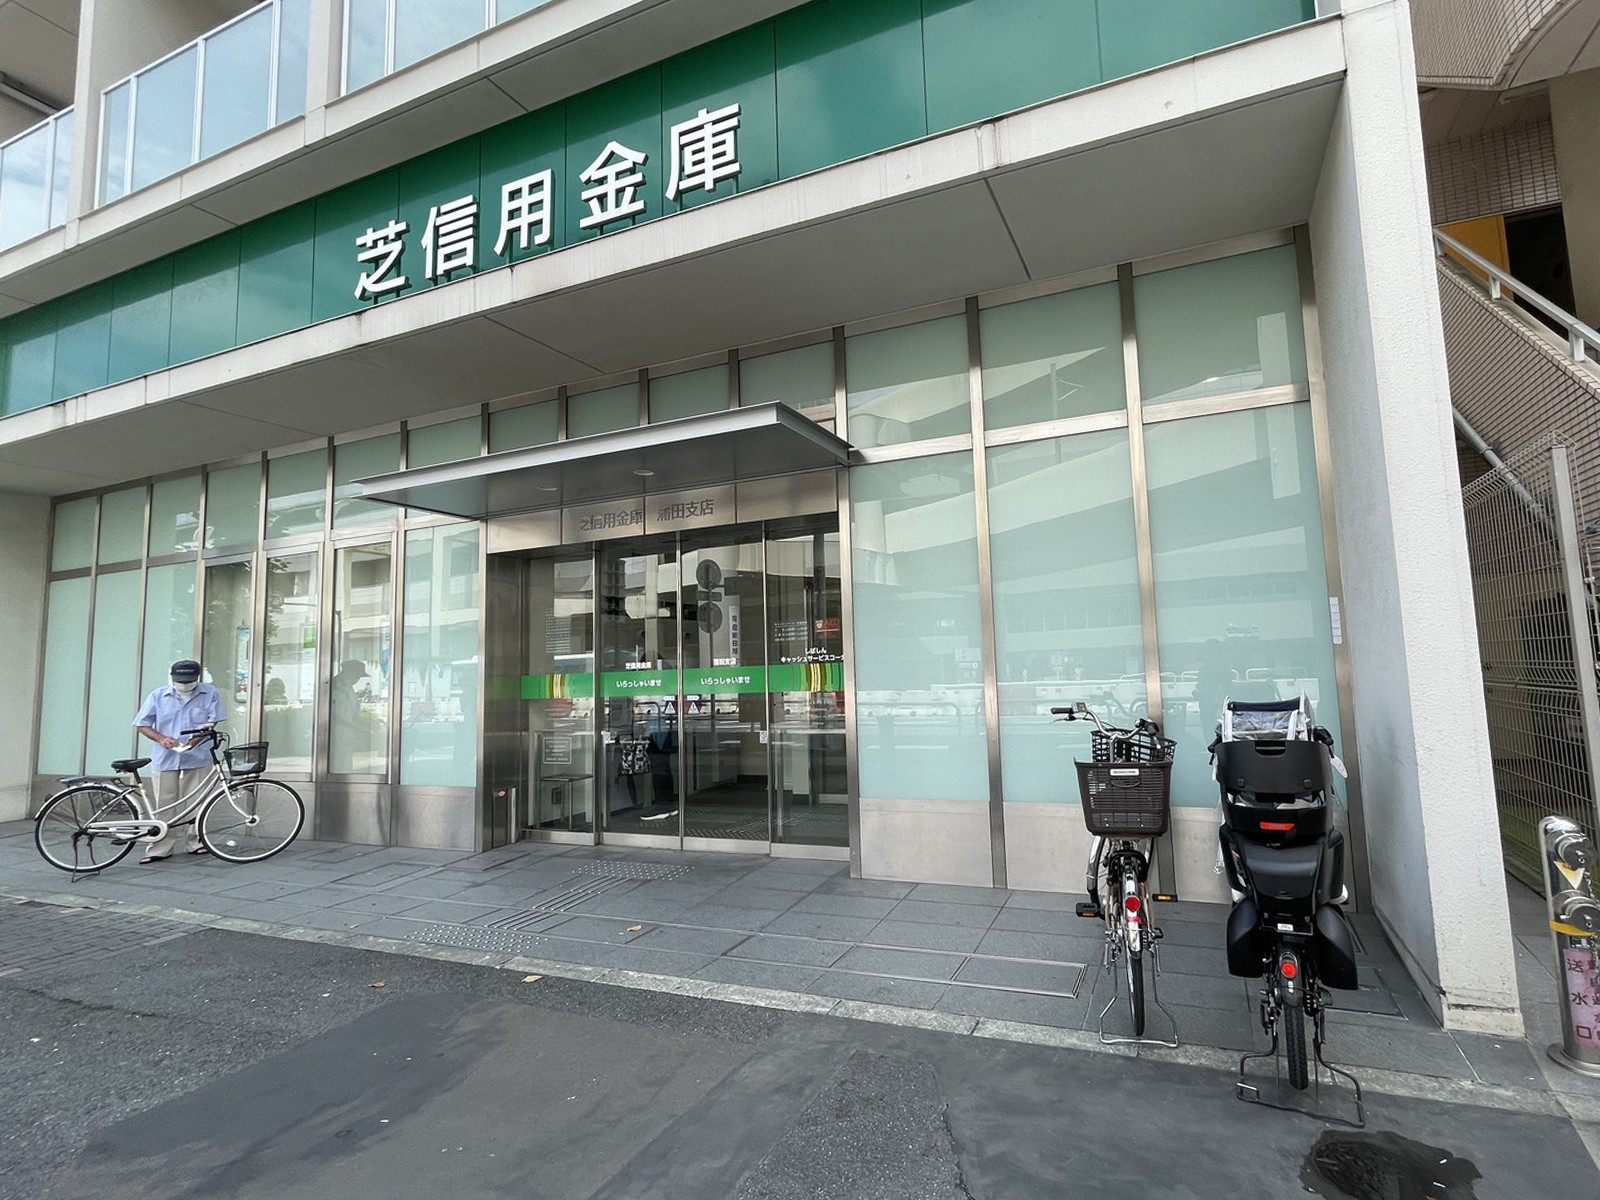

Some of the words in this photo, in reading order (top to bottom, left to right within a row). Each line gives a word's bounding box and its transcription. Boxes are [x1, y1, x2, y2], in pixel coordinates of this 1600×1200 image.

[353, 102, 740, 300] 芝信用金庫
[804, 647, 827, 655] しばしん
[616, 679, 662, 688] いらっしゃいませ
[700, 676, 751, 685] いらっしゃいませ
[1566, 957, 1592, 1040] 送水口
